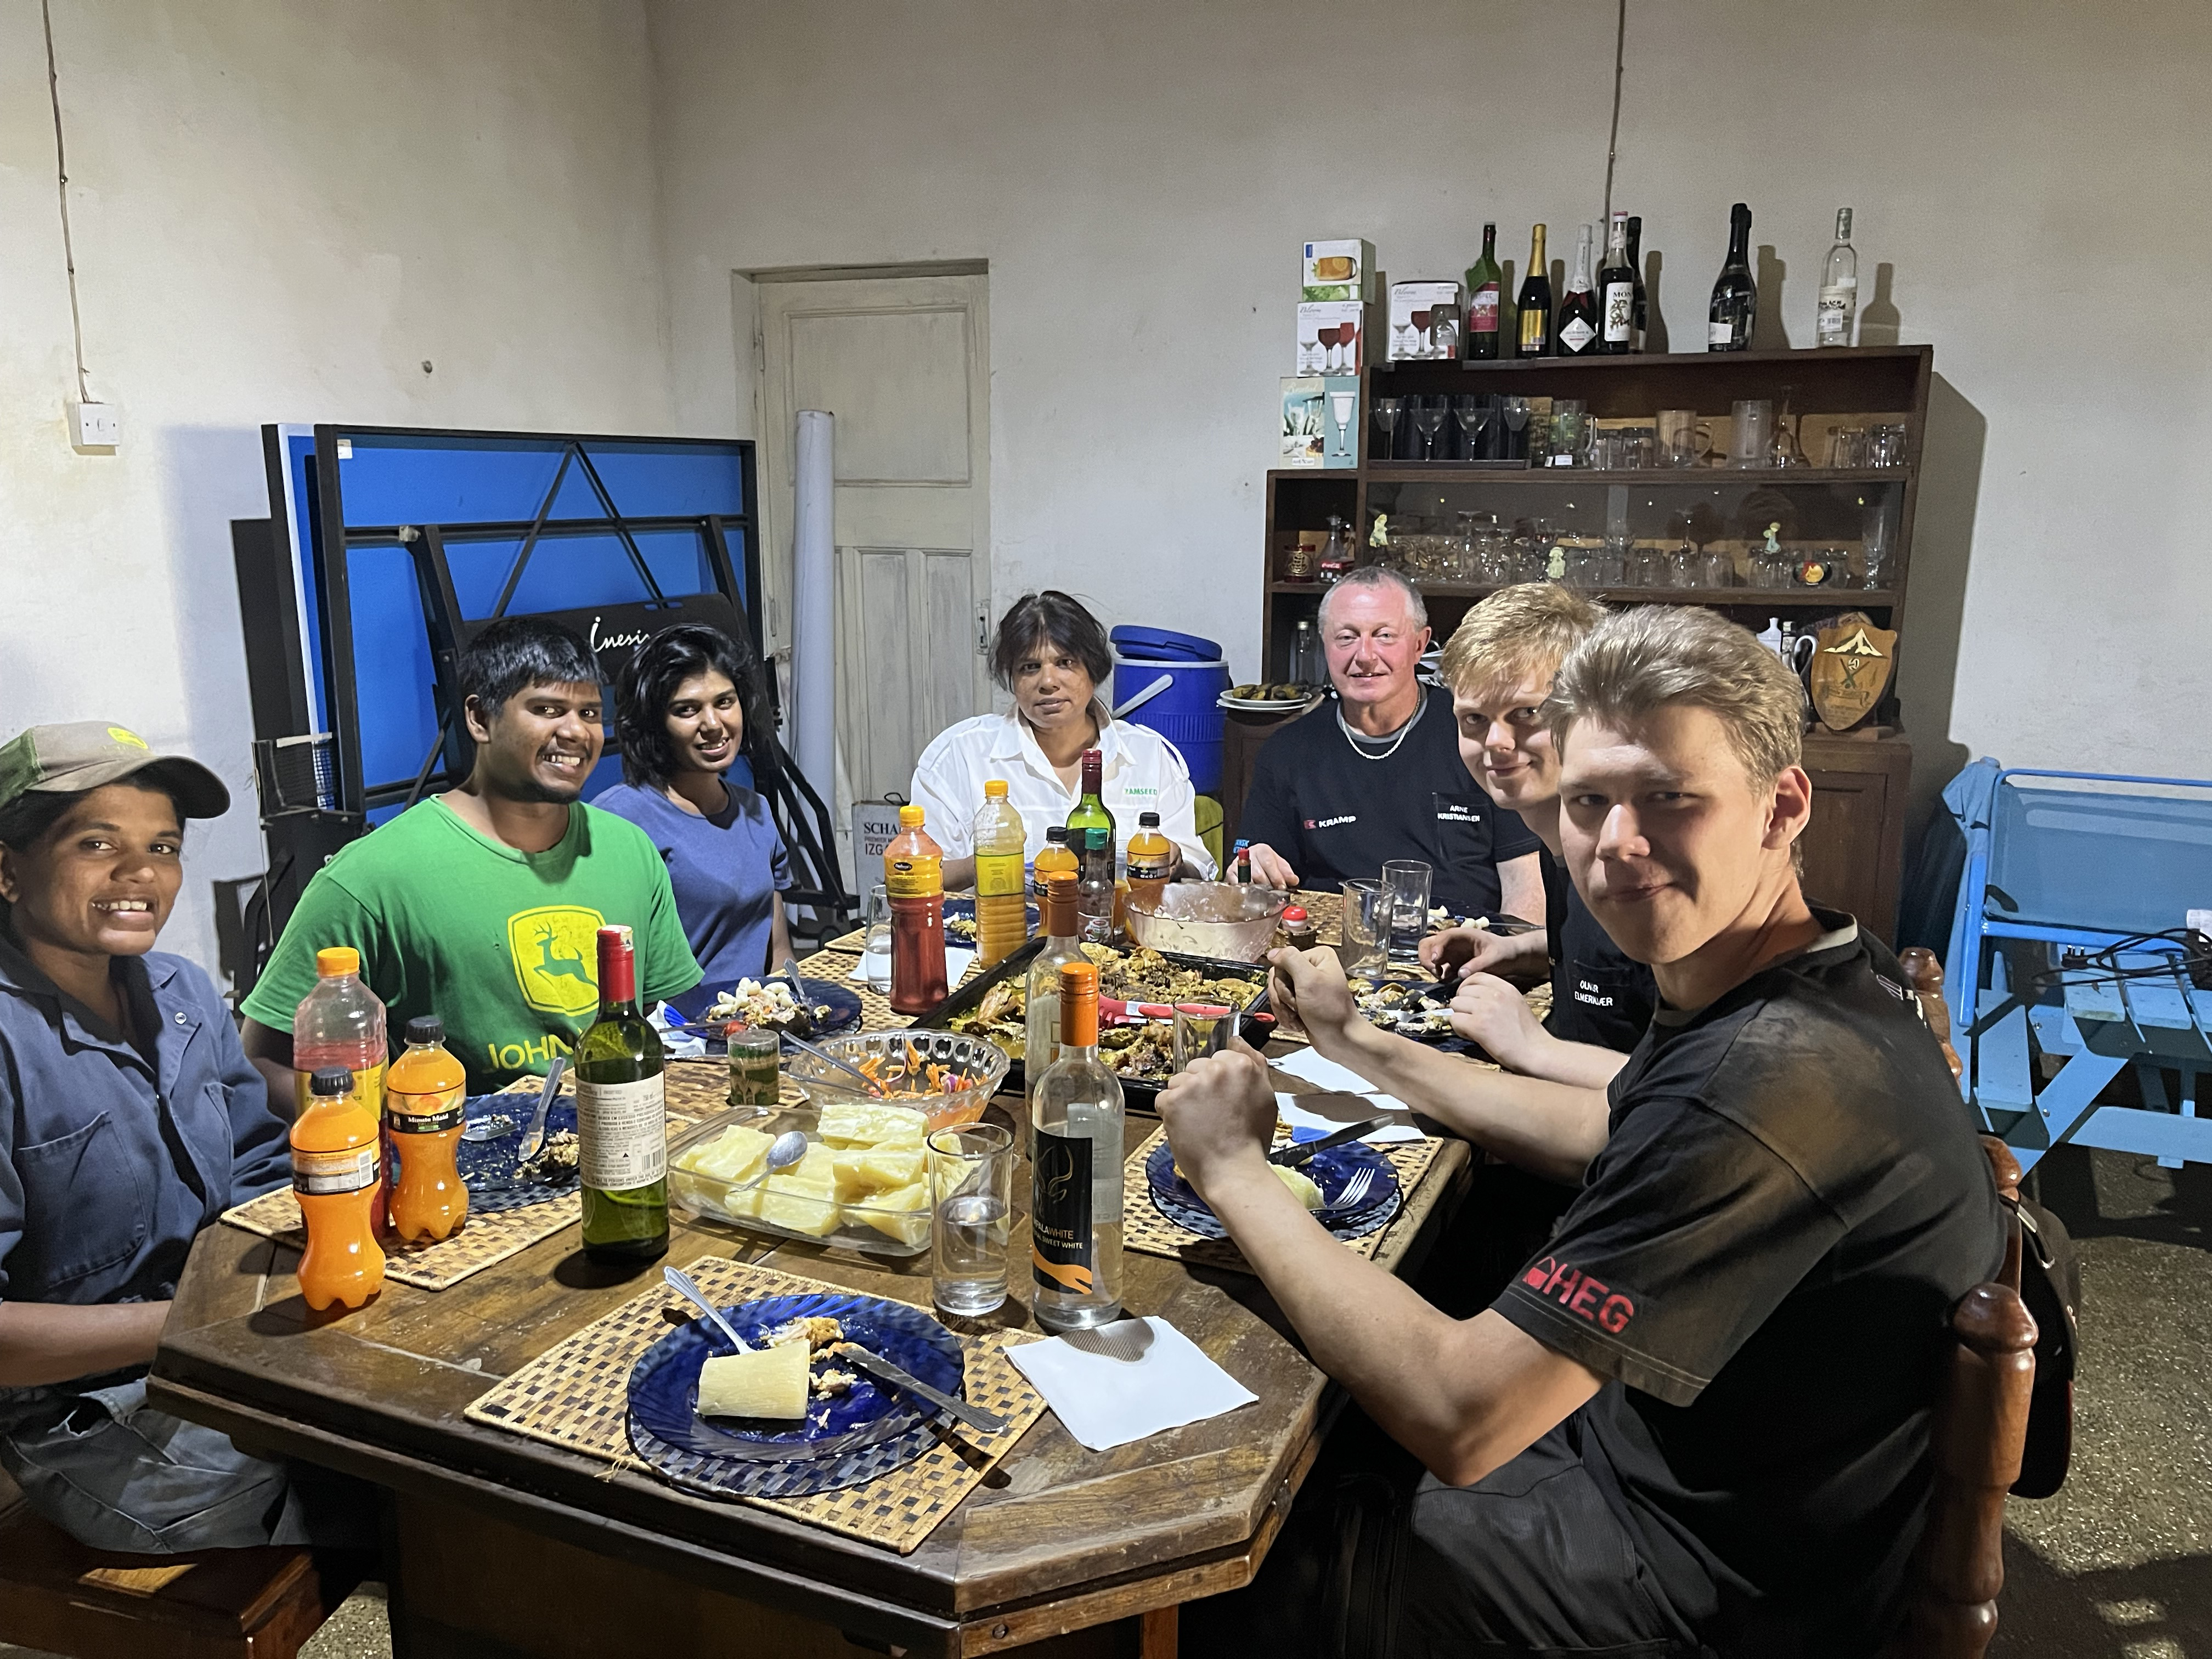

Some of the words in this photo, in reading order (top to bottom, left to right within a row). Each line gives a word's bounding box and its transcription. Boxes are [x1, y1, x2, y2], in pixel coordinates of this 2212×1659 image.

[1318, 815, 1357, 828] KRAMP
[432, 1113, 449, 1121] Maid
[1542, 1263, 1634, 1333] HEG
